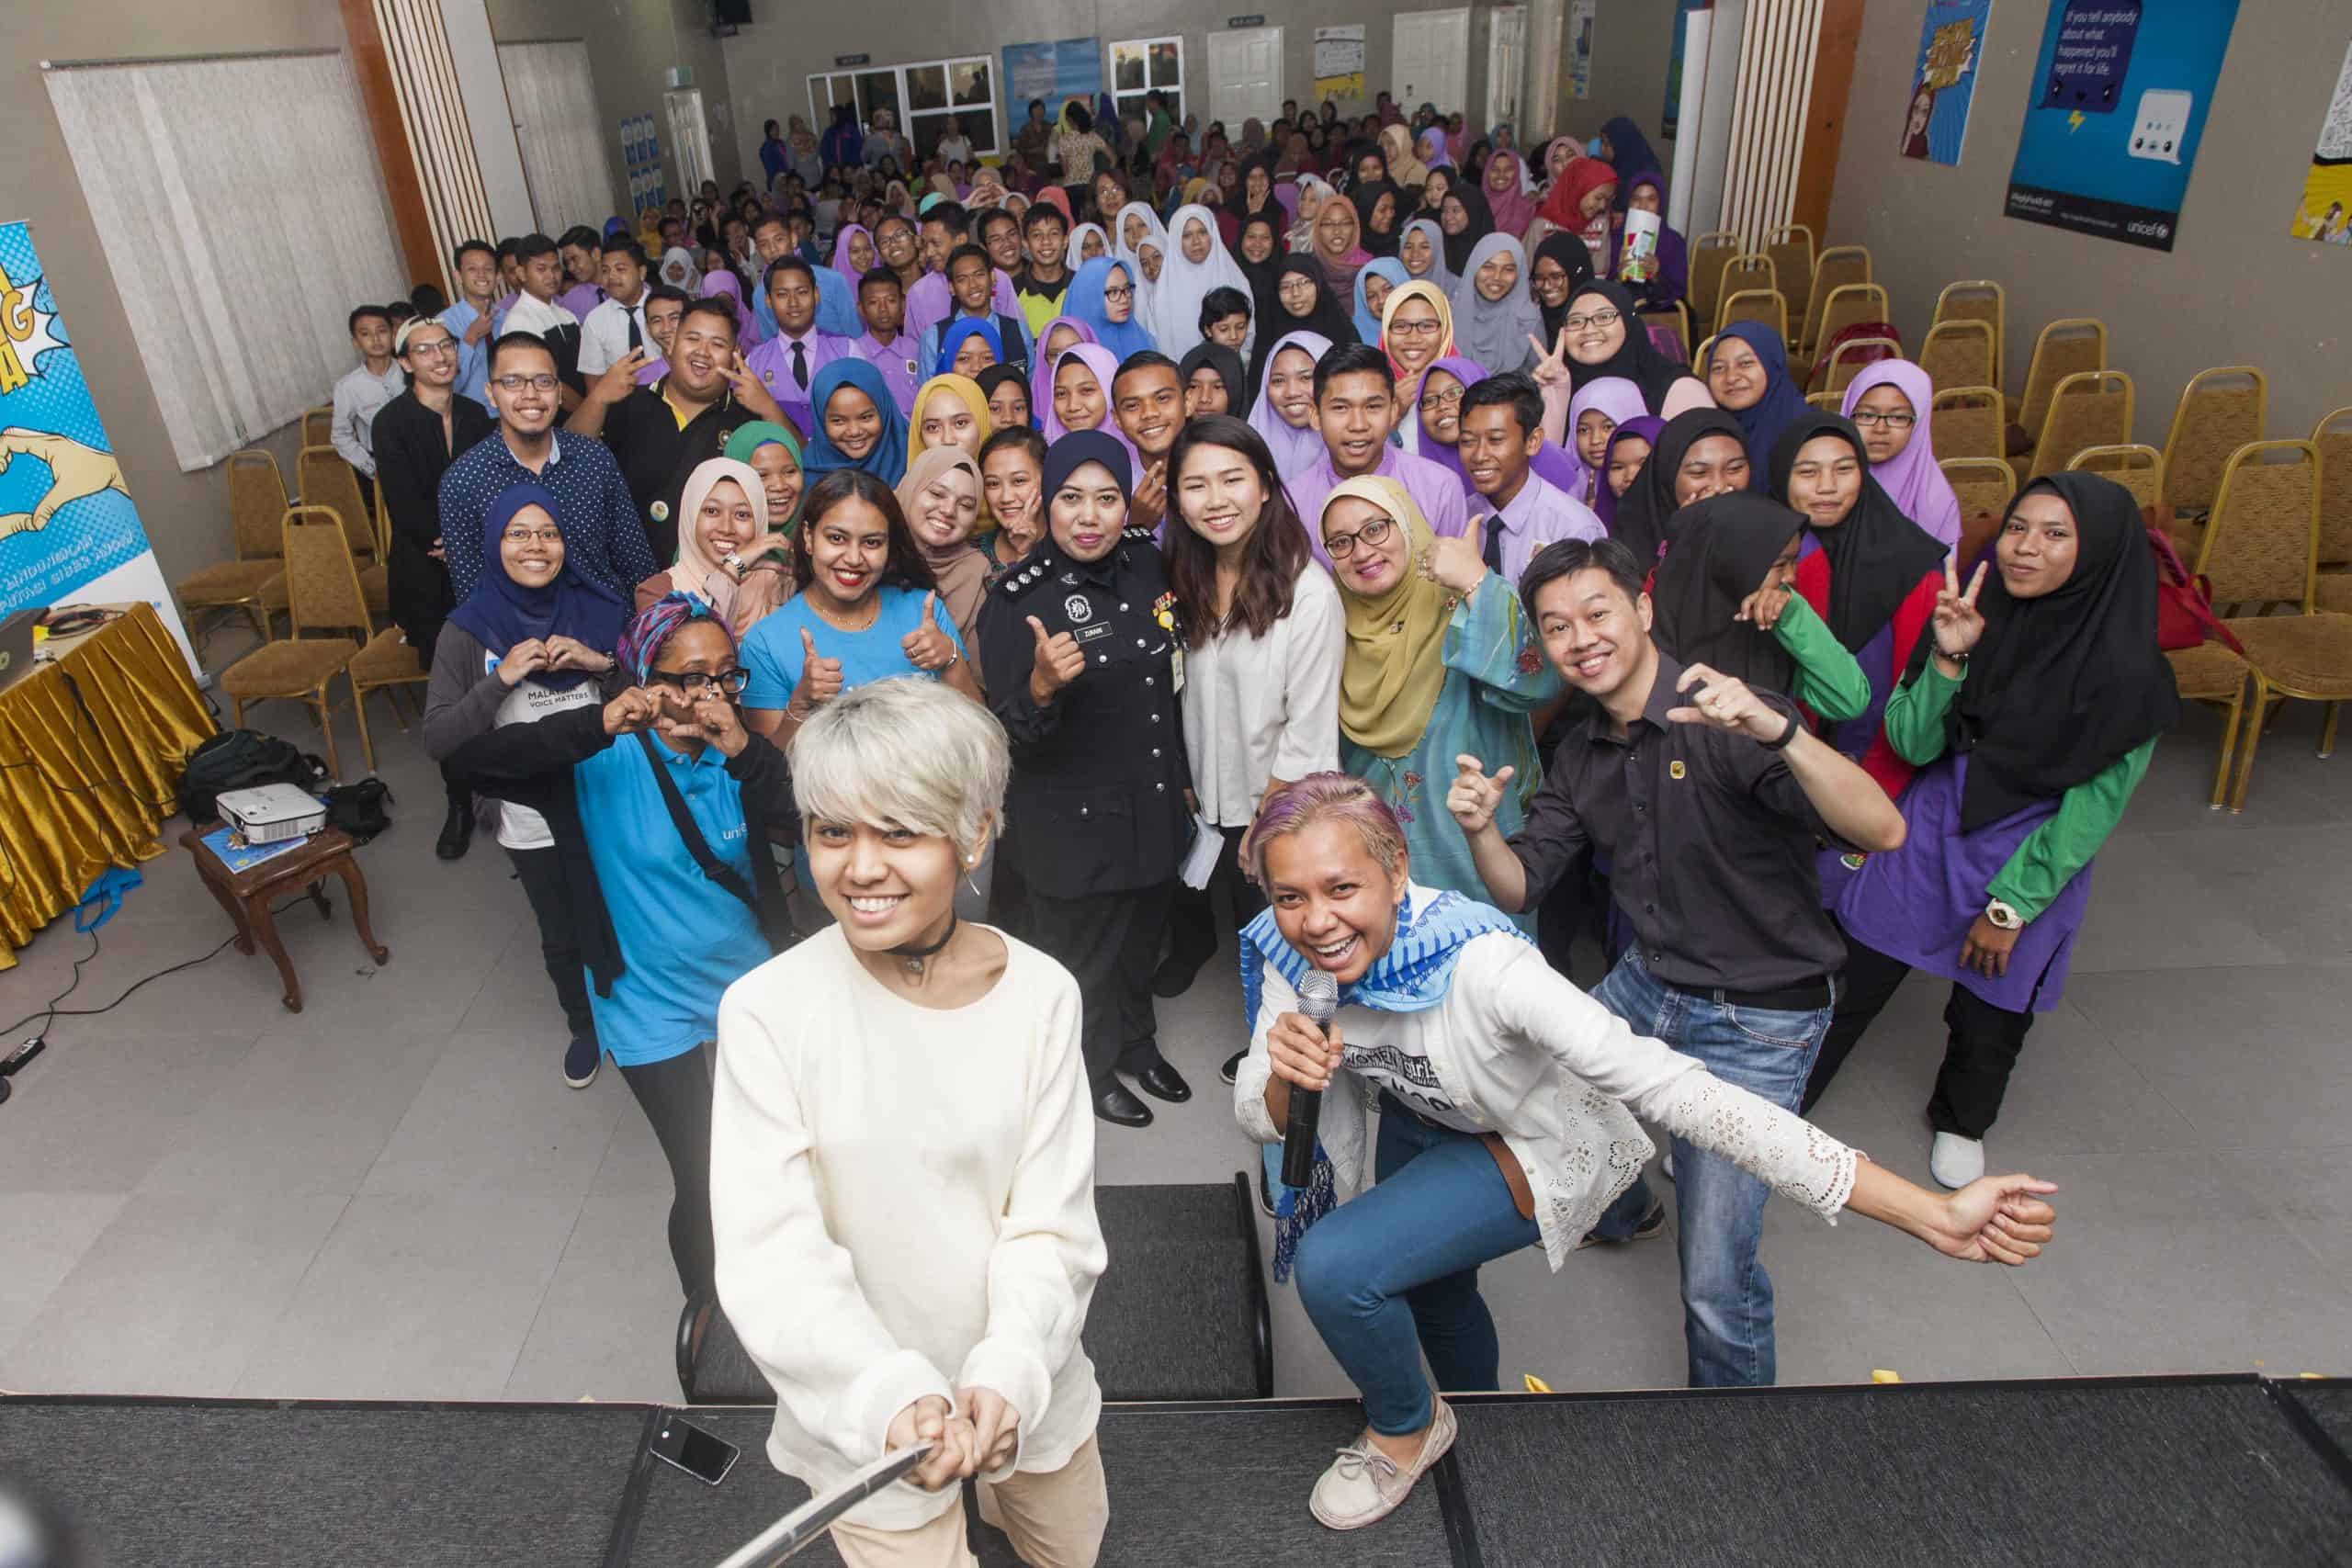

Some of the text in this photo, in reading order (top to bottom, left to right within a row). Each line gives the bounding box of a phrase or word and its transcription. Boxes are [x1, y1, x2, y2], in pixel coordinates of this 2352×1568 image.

[2073, 13, 2087, 25] you
[2087, 10, 2102, 22] tell
[2102, 10, 2138, 26] anybody
[2062, 28, 2104, 39] about what
[2058, 45, 2095, 59] happened
[2054, 62, 2076, 76] regret
[2083, 61, 2096, 73] for
[2127, 220, 2158, 235] unicef
[529, 692, 589, 707] VOICE MATTERS
